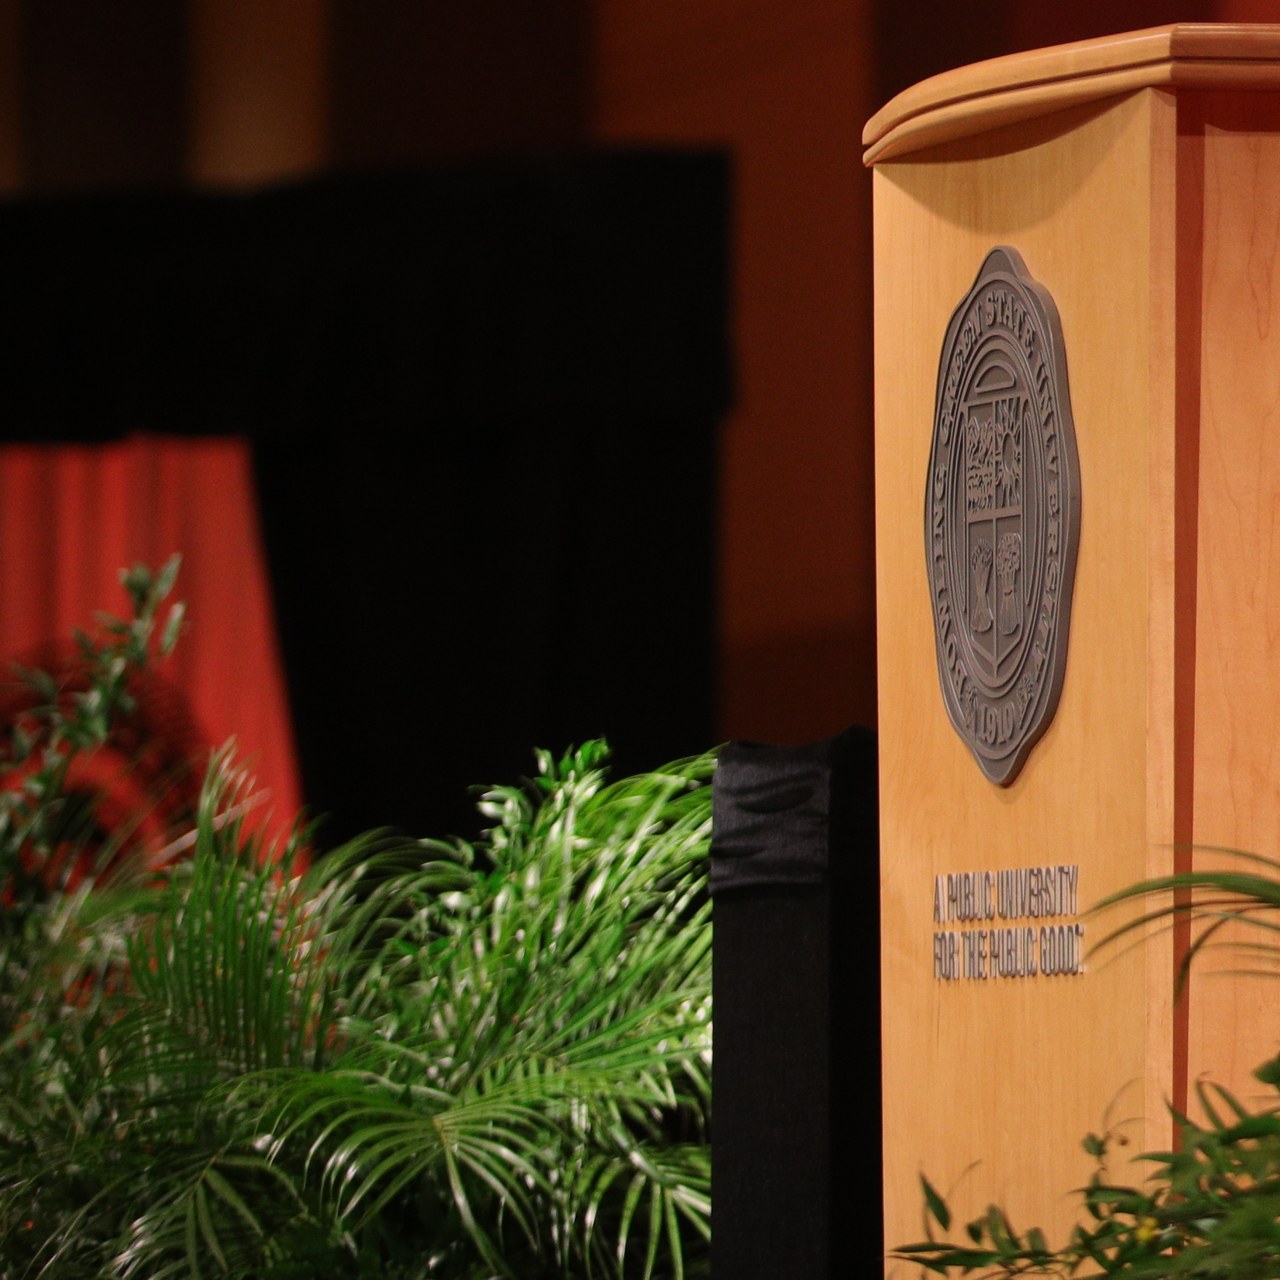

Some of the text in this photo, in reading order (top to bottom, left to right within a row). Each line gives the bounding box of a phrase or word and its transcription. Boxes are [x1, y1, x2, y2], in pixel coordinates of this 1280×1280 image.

[986, 289, 1036, 359] STATE
[940, 301, 983, 446] GREEN
[934, 463, 968, 700] BOWLING
[979, 701, 1016, 746] 1910
[934, 864, 1079, 924] A PUBLIC UNIVERSITY
[934, 931, 960, 981] FOR
[961, 930, 987, 979] THE
[989, 926, 1037, 978] PUBLIC
